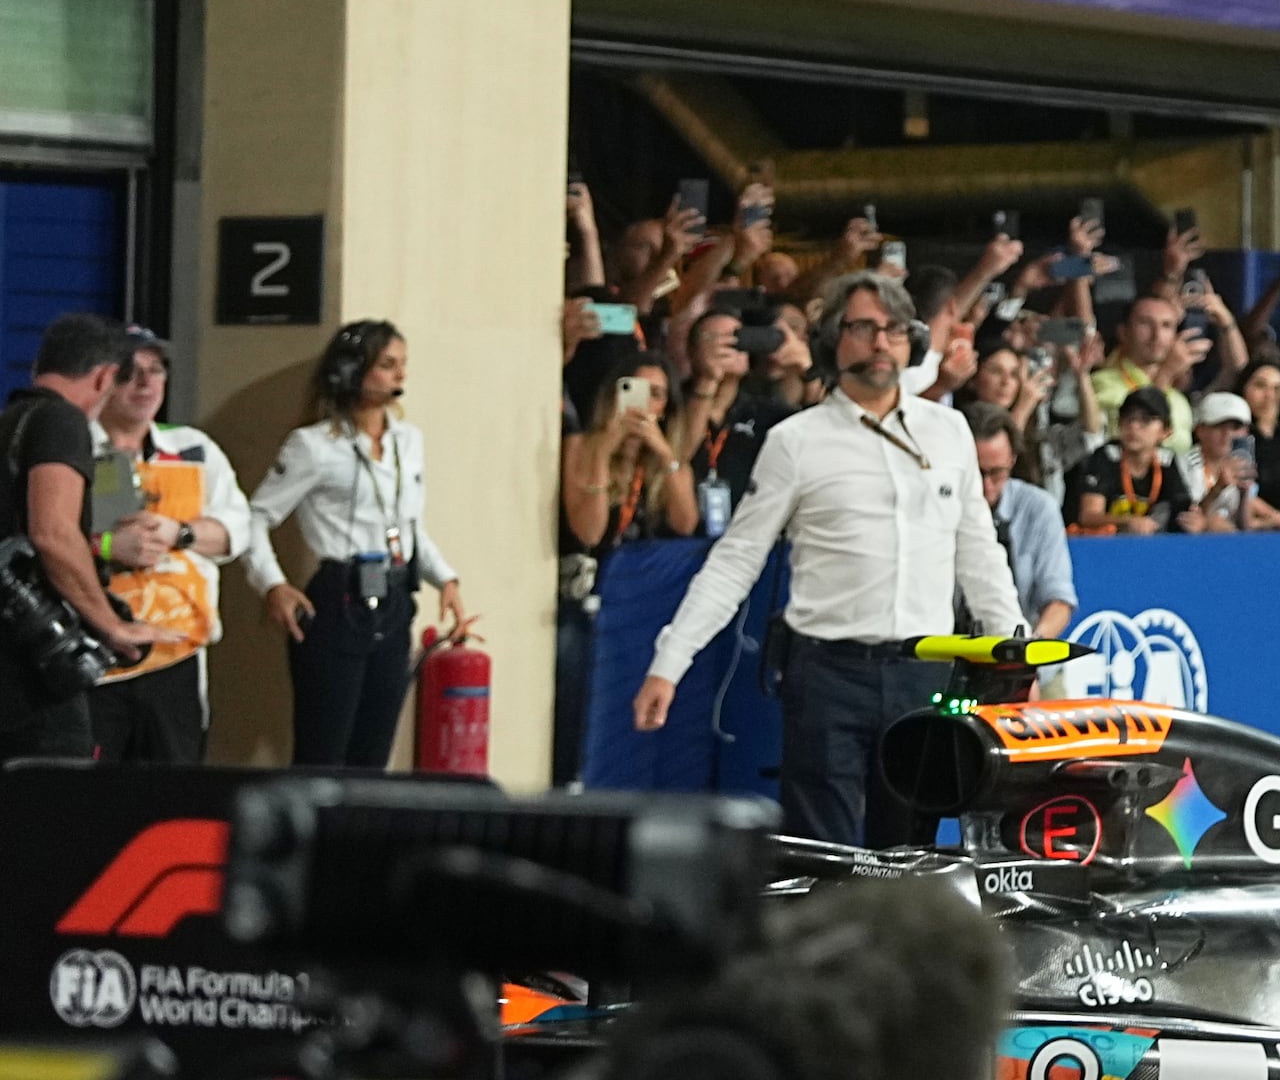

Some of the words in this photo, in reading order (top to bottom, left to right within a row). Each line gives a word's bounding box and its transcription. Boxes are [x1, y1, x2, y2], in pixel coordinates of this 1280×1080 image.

[251, 241, 291, 296] 2
[852, 866, 903, 879] MOUNTAIN
[854, 854, 878, 865] IRON
[984, 868, 1034, 894] okta
[187, 967, 296, 1002] Formula
[140, 994, 218, 1027] World
